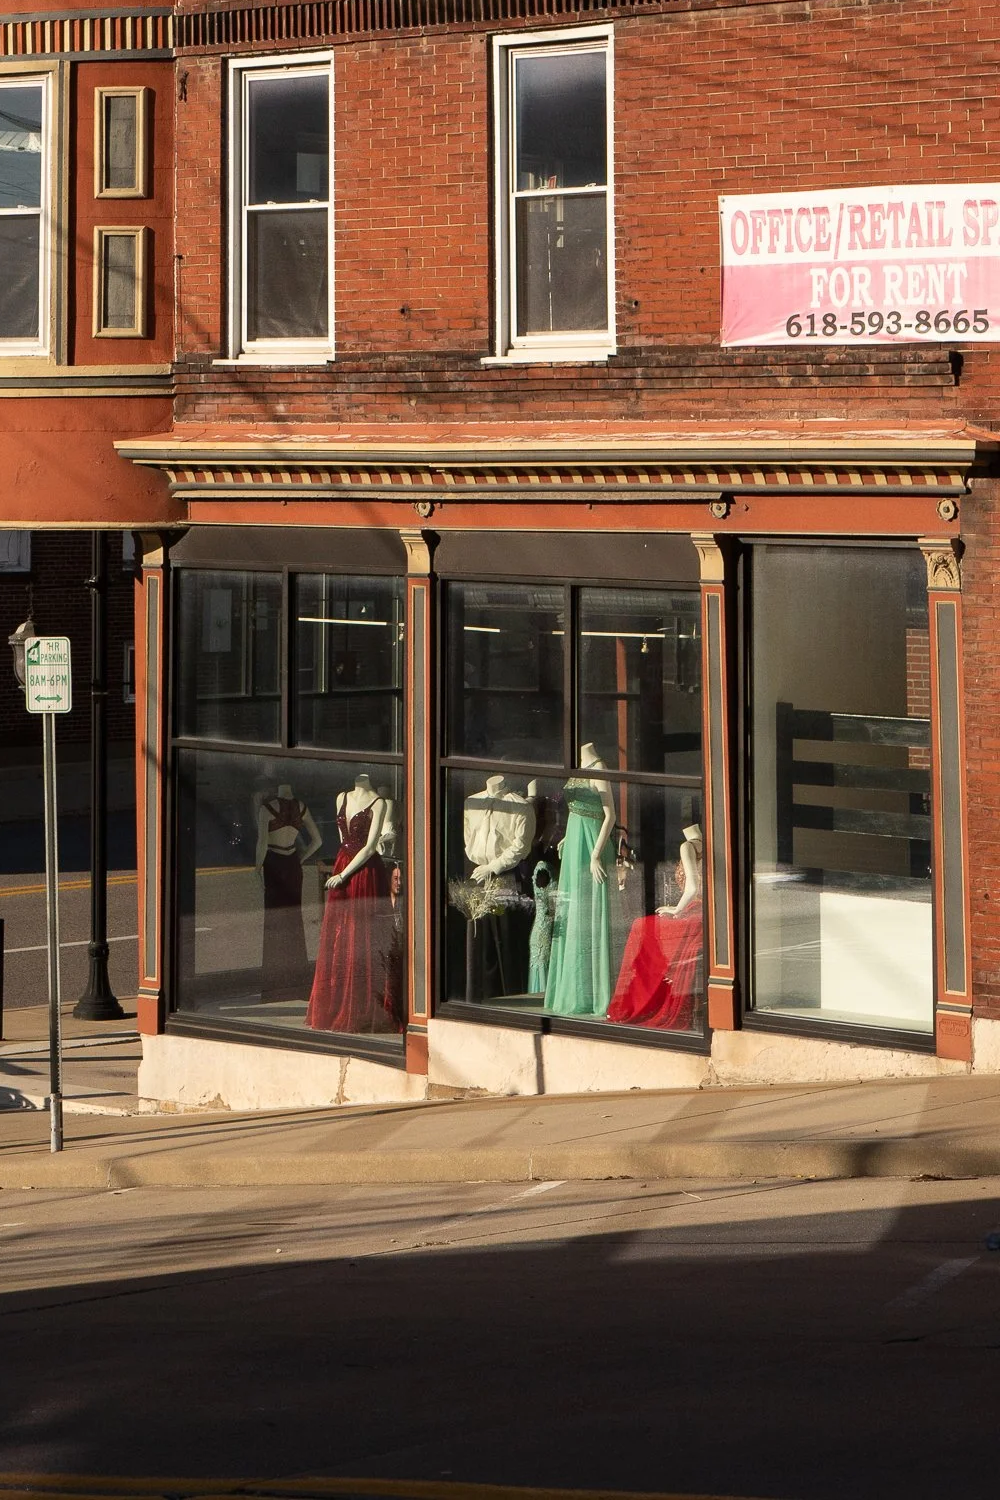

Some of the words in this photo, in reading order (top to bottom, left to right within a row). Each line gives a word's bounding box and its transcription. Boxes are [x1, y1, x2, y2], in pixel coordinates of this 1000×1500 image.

[730, 200, 953, 259] OFFICE/RETAIL
[809, 267, 874, 308] FOR
[883, 263, 968, 306] RENT
[785, 308, 990, 338] 618-593-8665
[47, 642, 60, 651] HR
[40, 653, 68, 663] PARKING
[29, 674, 67, 686] 8AM-6PM
